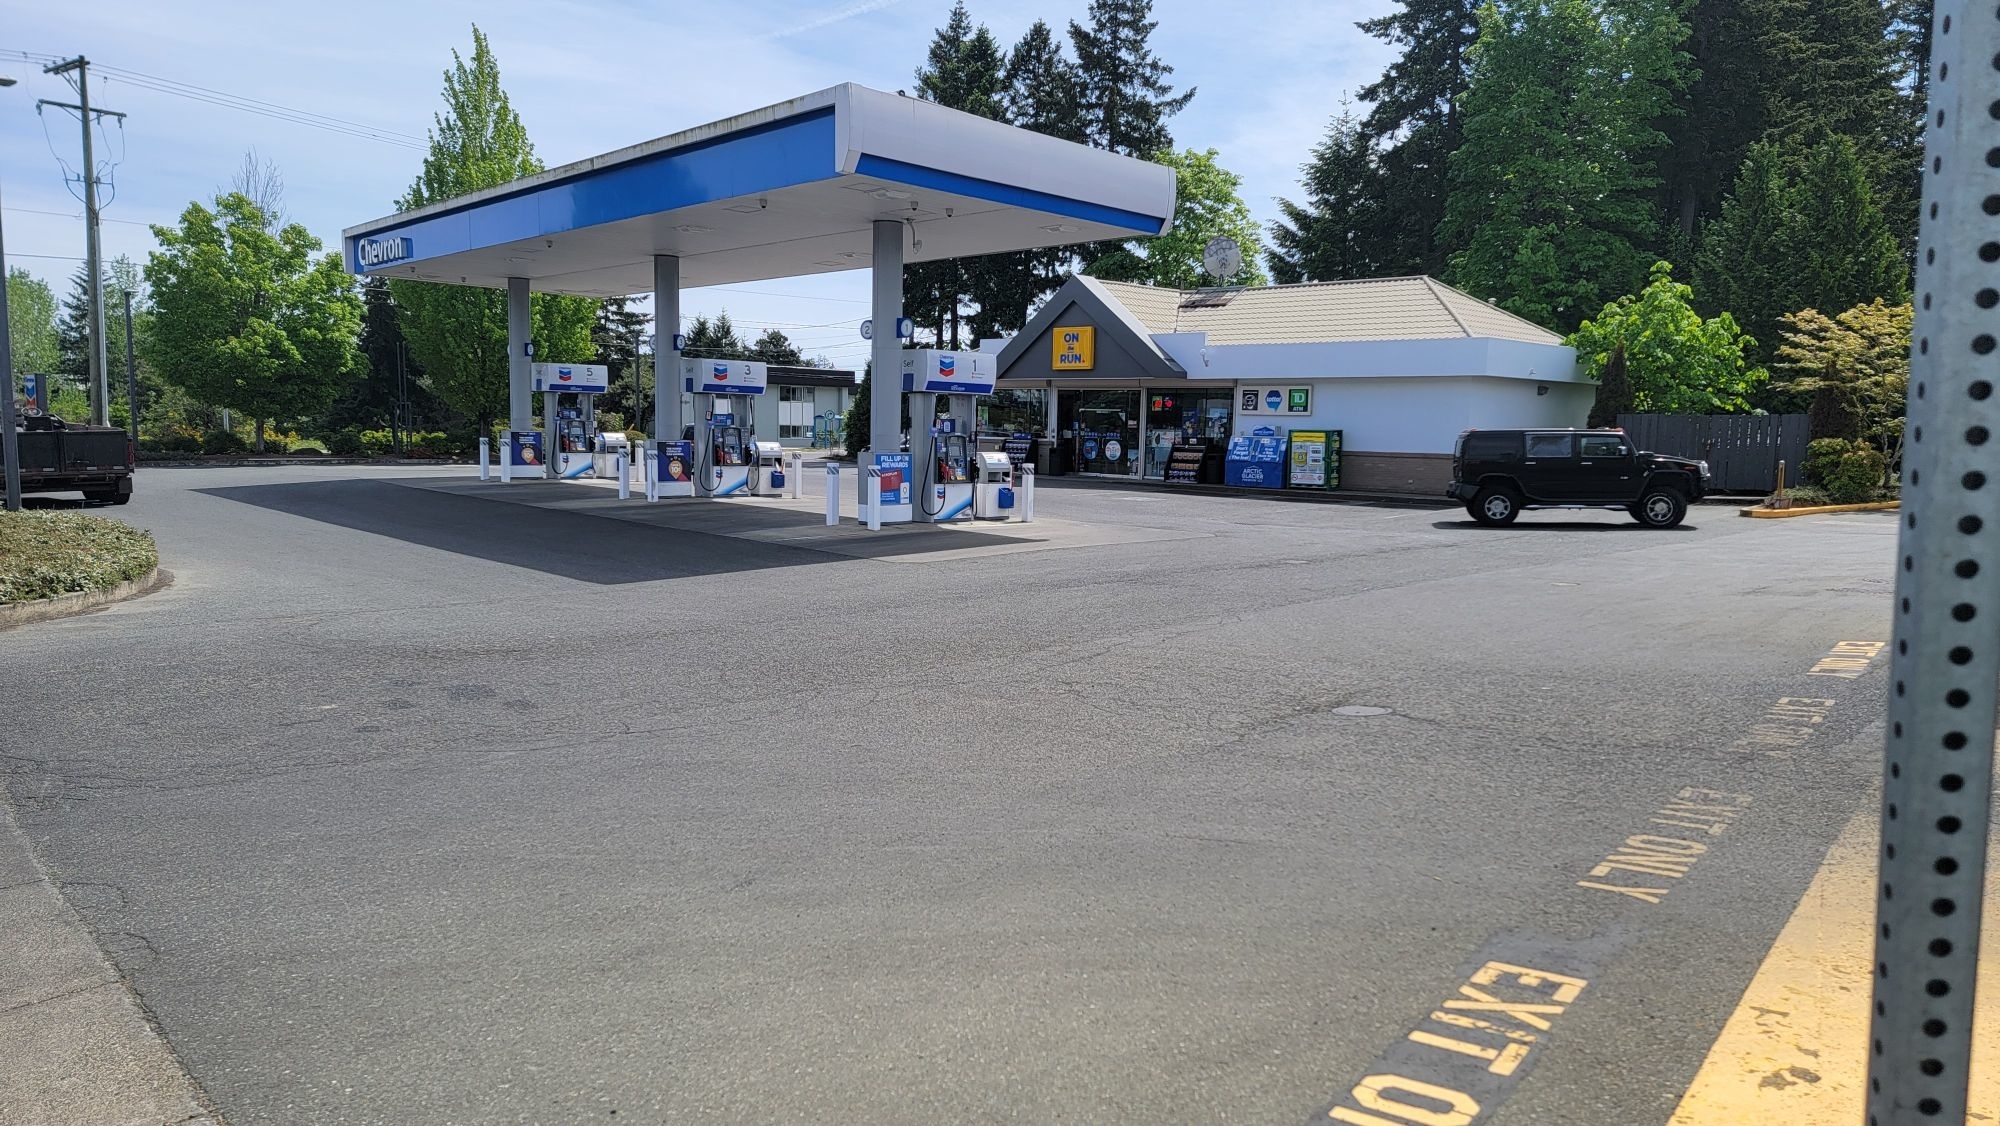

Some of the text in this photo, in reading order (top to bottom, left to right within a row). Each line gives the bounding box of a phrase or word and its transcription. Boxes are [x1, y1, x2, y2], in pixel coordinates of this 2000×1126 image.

[358, 237, 402, 266] Chevron
[1063, 333, 1079, 343] ON
[744, 364, 752, 376] 3
[903, 360, 914, 368] Self
[586, 367, 594, 377] 5
[1292, 393, 1305, 403] TD
[1828, 640, 1886, 657] EXIT
[1763, 696, 1836, 725] EXIT
[1576, 786, 1753, 904] EXIT ONLY
[1407, 960, 1589, 1077] EXIT
